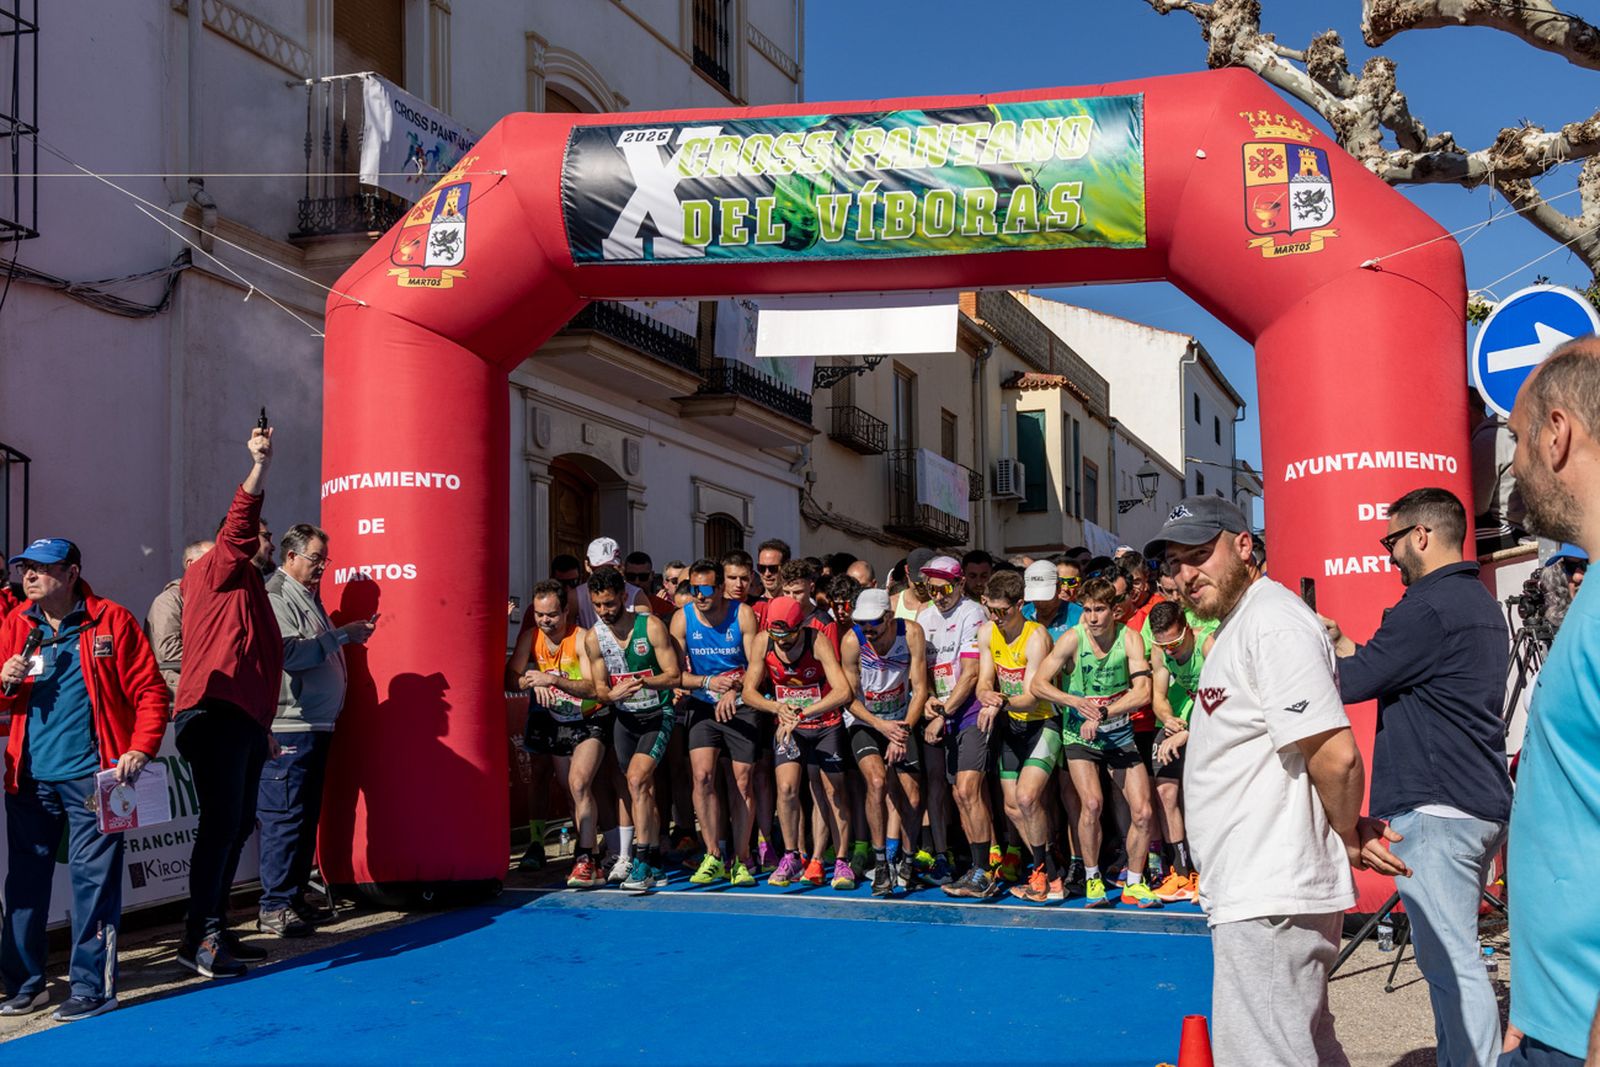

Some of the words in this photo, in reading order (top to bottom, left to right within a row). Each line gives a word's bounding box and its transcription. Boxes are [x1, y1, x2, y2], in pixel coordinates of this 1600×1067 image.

[394, 99, 429, 131] CROSS
[624, 131, 669, 142] 2026
[678, 129, 835, 178] CROSS
[846, 114, 1095, 172] PANTANO
[602, 126, 722, 260] X
[681, 197, 790, 248] DEL
[816, 180, 1084, 243] VÍBORAS
[1274, 242, 1311, 255] MARTOS
[408, 278, 442, 287] MARTOS
[1284, 451, 1457, 482] AYUNTAMIENTO
[1358, 503, 1393, 521] DE
[358, 518, 385, 535] DE
[335, 563, 418, 584] MARTOS
[1324, 555, 1402, 576] MART
